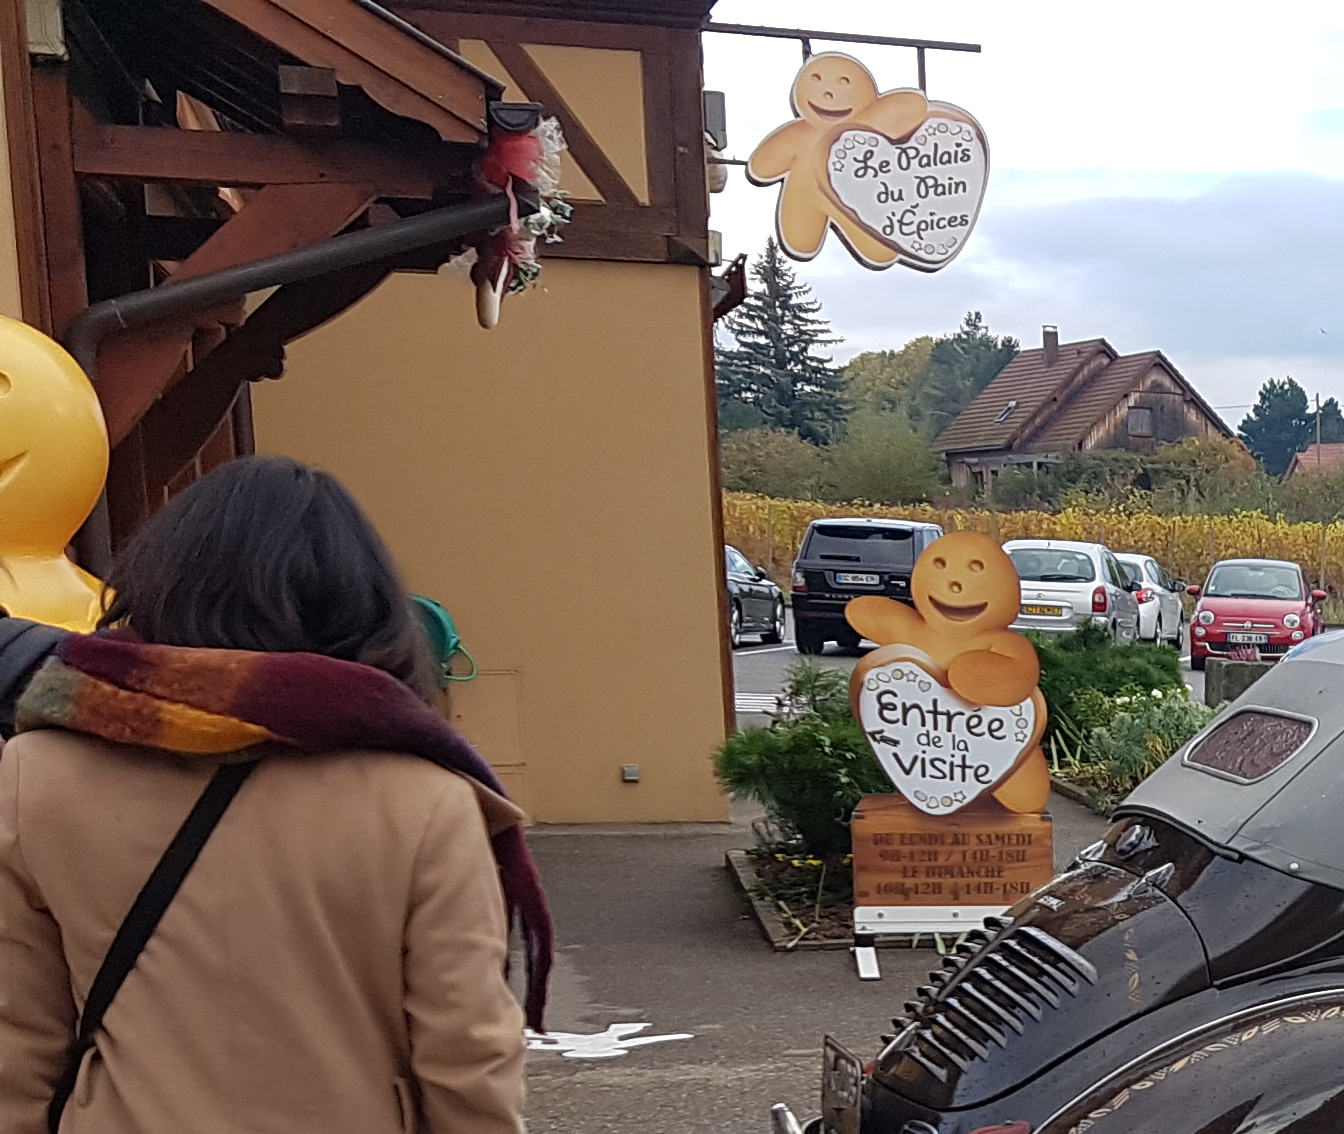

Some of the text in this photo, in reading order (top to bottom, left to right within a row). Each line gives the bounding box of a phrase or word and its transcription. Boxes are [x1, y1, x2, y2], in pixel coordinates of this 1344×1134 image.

[853, 142, 971, 178] Le Palais
[876, 175, 967, 204] du Pain
[881, 203, 970, 241] d'Épices
[876, 689, 1006, 740] Entrée
[916, 730, 969, 752] de la
[891, 750, 992, 784] visite
[949, 833, 971, 845] AU
[975, 833, 1033, 845] SAMEDI
[902, 866, 1005, 878] LE DIMANCHE
